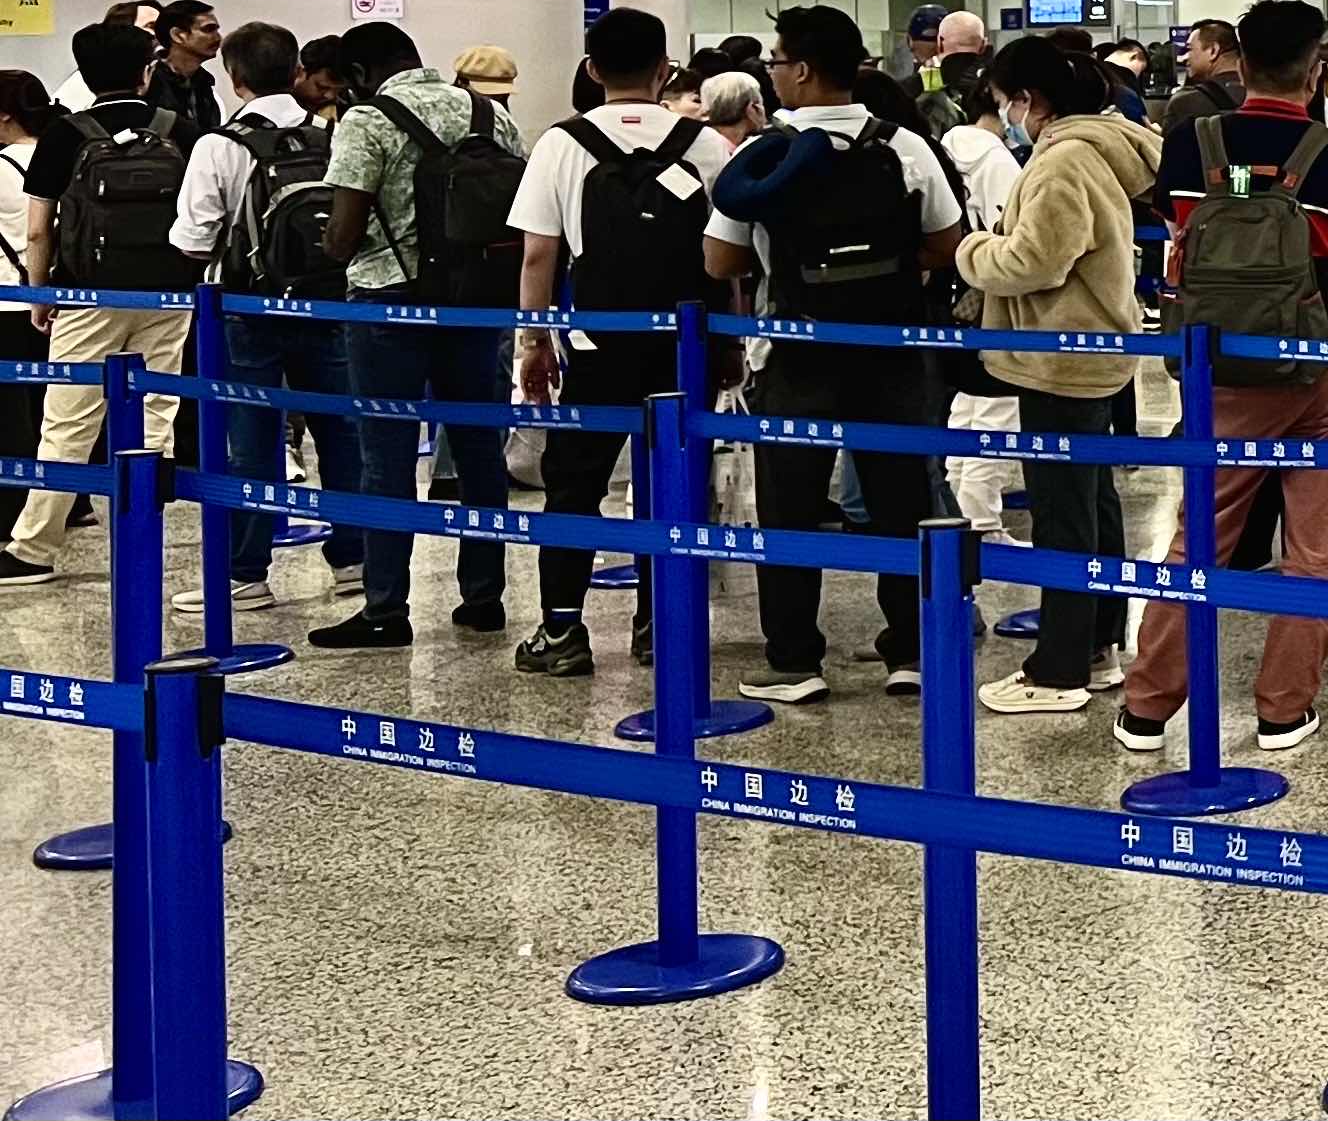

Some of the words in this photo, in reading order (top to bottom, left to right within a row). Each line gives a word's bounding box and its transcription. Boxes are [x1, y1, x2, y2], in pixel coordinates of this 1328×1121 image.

[342, 716, 474, 758] 中国边检
[343, 745, 367, 756] CHINA
[370, 749, 424, 765] IMMIGRATION
[427, 759, 476, 773] INSPECTION
[702, 766, 854, 811] 中国边检
[702, 798, 729, 810] CHINA
[734, 803, 796, 820] IMMIGRATION
[799, 813, 856, 829] INSPECTION
[1121, 820, 1302, 866] 中国边检
[1122, 854, 1154, 868] CHINA
[1159, 859, 1232, 877] IMMIGRATION
[1236, 869, 1303, 885] INSPECTION
